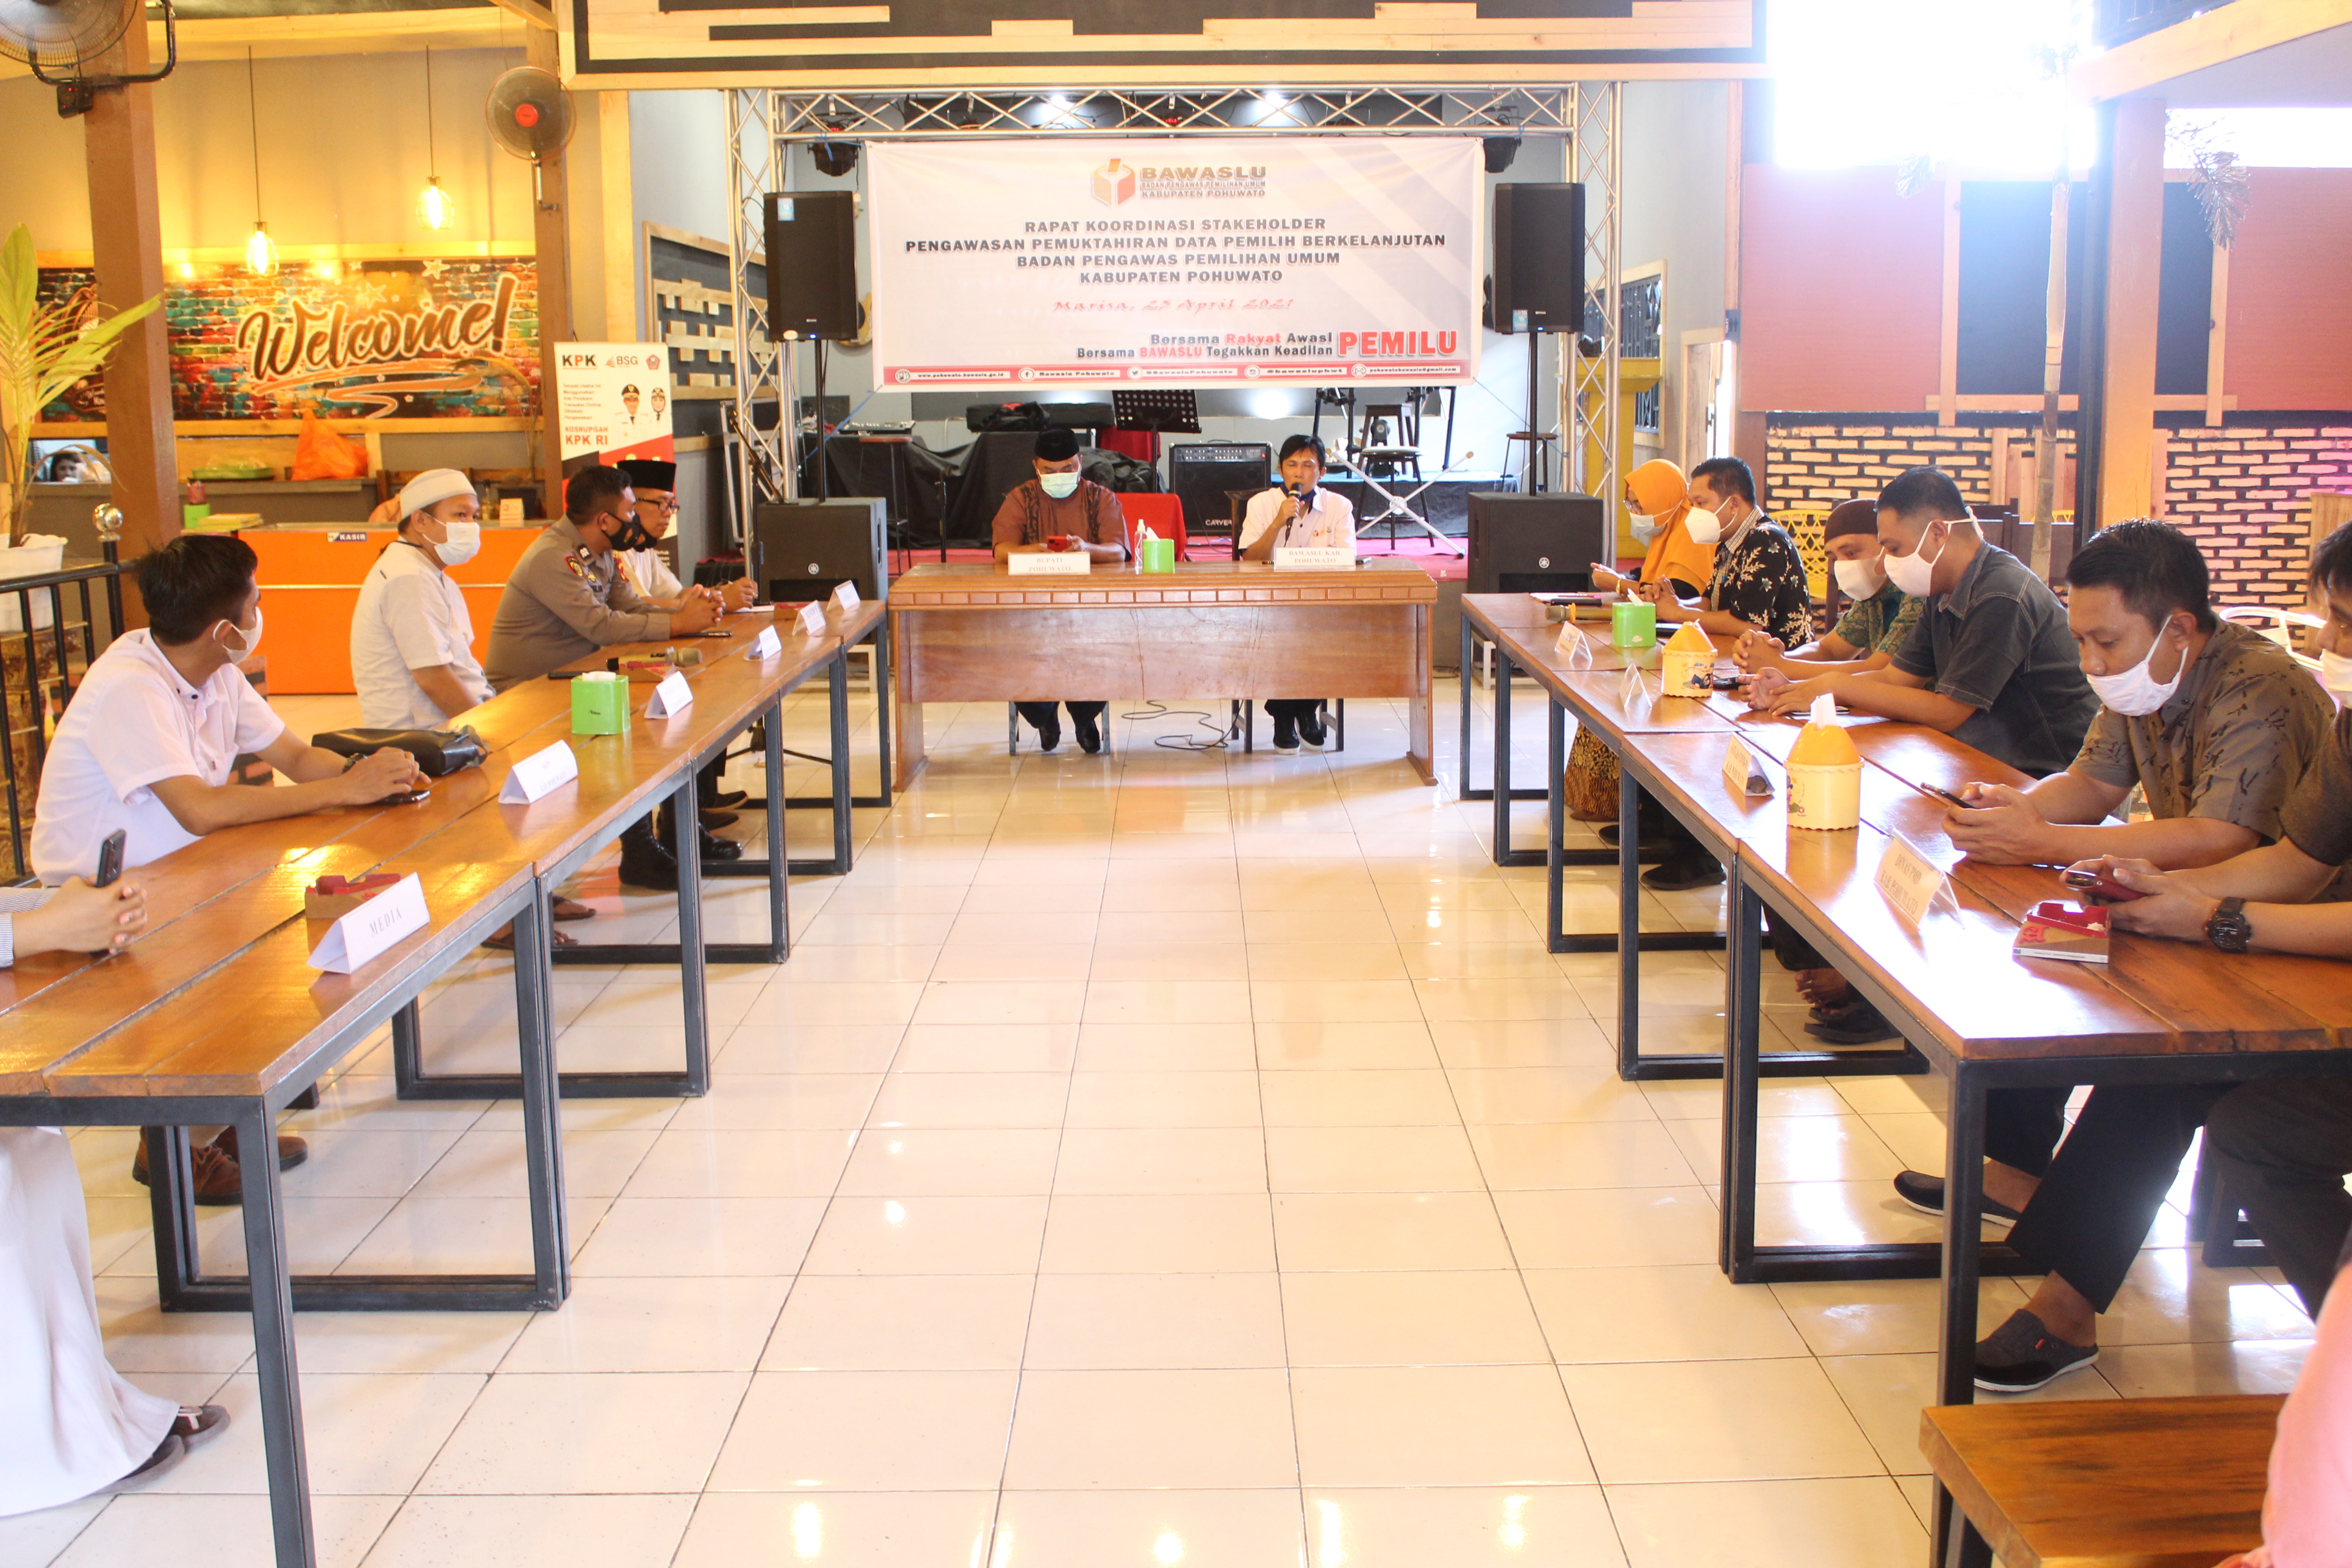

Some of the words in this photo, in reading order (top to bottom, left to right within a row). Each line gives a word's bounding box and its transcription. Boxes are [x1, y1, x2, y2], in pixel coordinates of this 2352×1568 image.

[1142, 166, 1266, 180] BAWASLU
[1024, 221, 1079, 232] RAPAT
[1086, 220, 1195, 231] KOORDINASI
[1201, 218, 1326, 230] STAKEHOLDER
[906, 240, 1025, 252] PENGAWASAN
[1032, 237, 1168, 250] PEMUKTAHIRAN
[1176, 236, 1217, 248] DATA
[1224, 235, 1295, 247] PEMILIH
[1303, 235, 1446, 247] BERKELANJUTAN
[1017, 255, 1075, 267] BADAN
[1082, 254, 1178, 266] PENGAWAS
[1185, 253, 1280, 265] PEMILIHAN
[1288, 252, 1340, 264] UMUM
[1080, 272, 1180, 283] KABUPATEN
[1187, 270, 1283, 282] POHUWATO
[1178, 298, 1235, 314] April
[1242, 298, 1294, 309] 2021
[238, 273, 519, 381] Welcome!
[1151, 334, 1220, 345] Bersama
[1226, 333, 1281, 346] Rakyat
[1339, 330, 1458, 356] PEMILU
[1078, 347, 1135, 358] Bersama
[1140, 346, 1202, 358] BAWASLU
[1207, 345, 1269, 358] Tegakkan
[1274, 344, 1333, 356] Keadilan
[562, 355, 596, 366] KPK
[617, 356, 637, 364] BSG
[566, 435, 590, 445] KPK
[596, 435, 607, 445] RI
[369, 907, 402, 936] MEDIA
